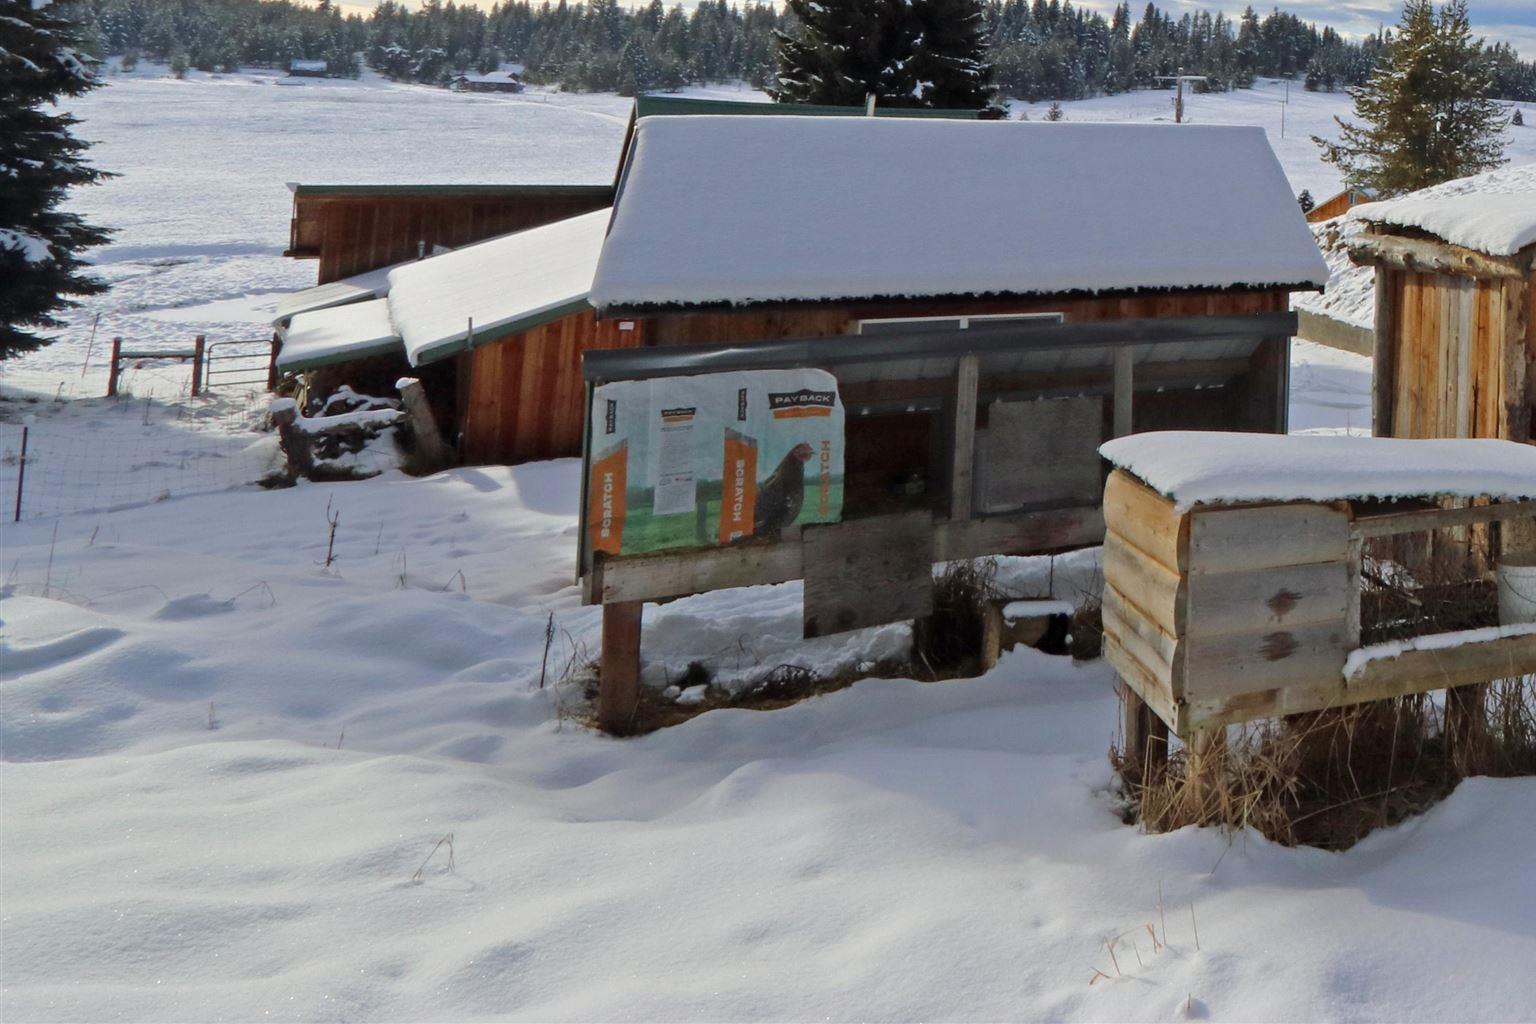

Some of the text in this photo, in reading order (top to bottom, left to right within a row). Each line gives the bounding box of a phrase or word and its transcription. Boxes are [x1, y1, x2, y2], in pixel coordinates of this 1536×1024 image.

[774, 394, 831, 404] PAYBACK
[601, 472, 613, 538] SCRATCH
[732, 459, 744, 522] SCRATCH
